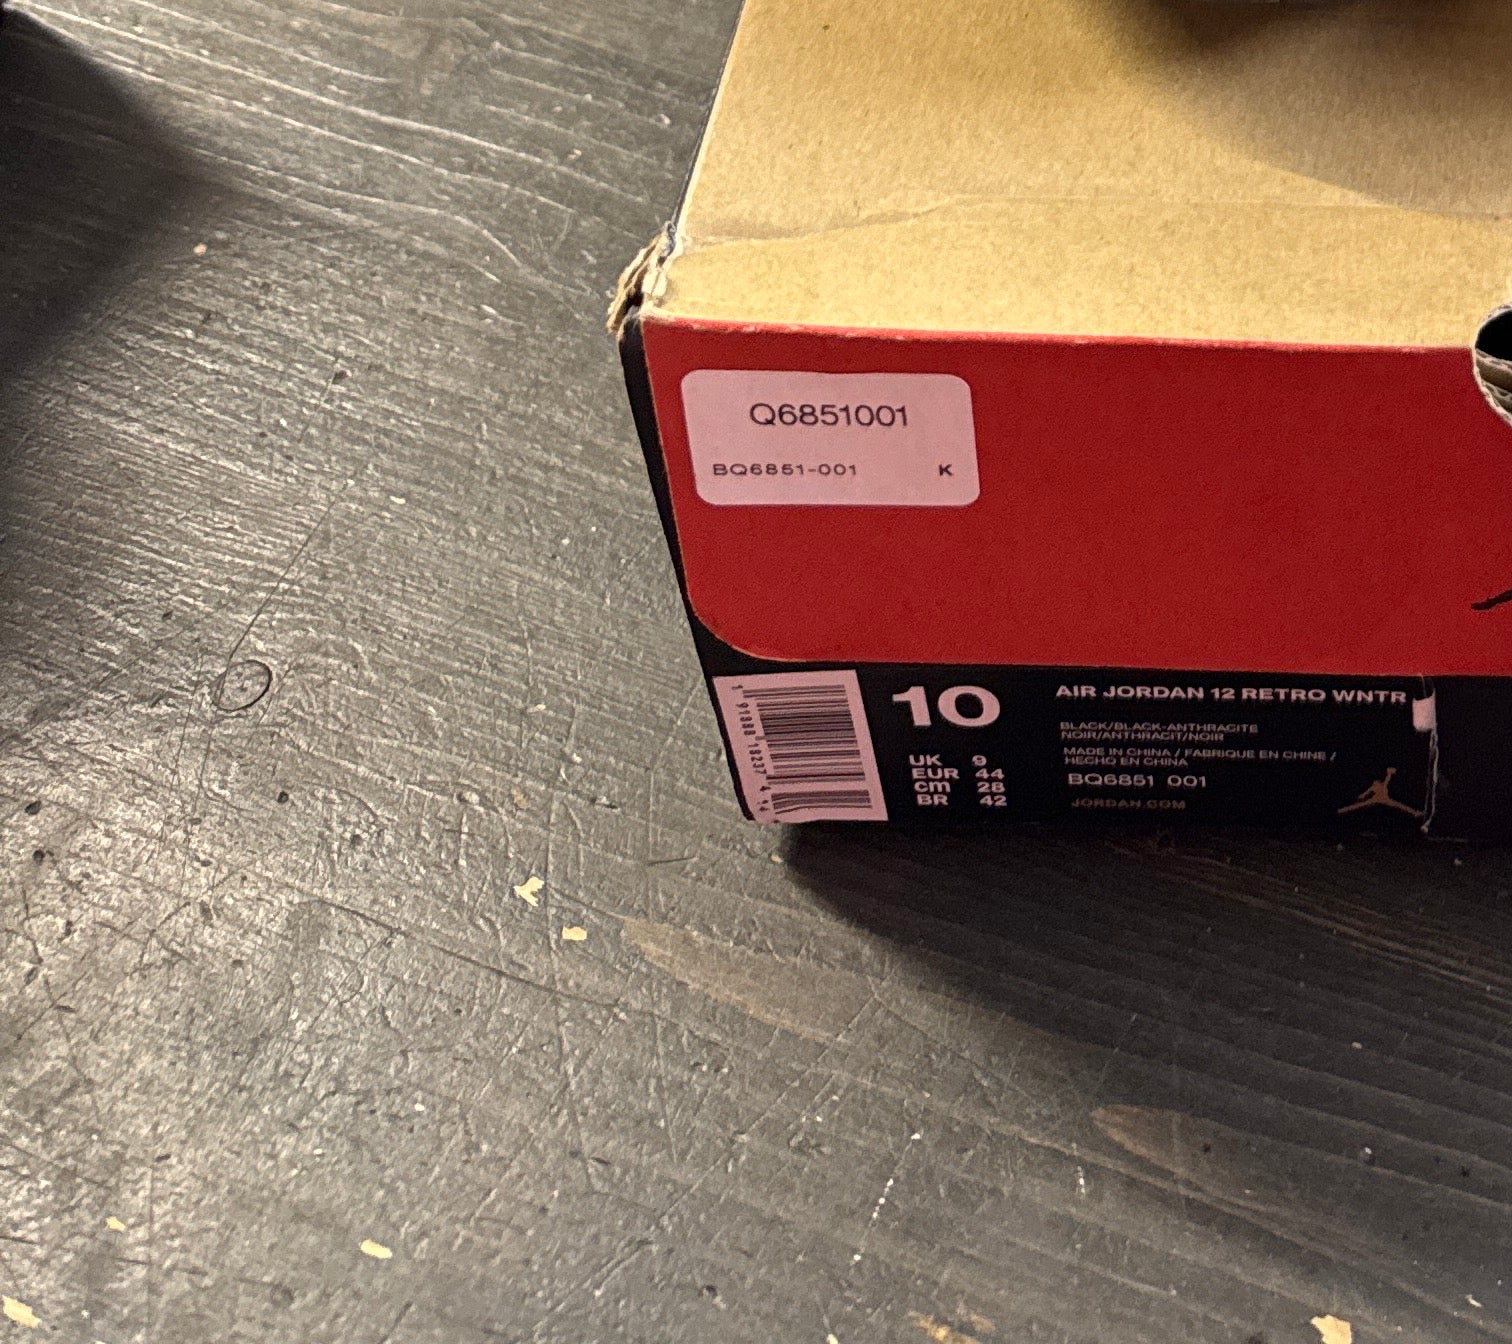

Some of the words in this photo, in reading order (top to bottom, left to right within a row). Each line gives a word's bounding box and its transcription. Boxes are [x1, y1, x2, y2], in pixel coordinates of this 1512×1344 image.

[750, 402, 908, 427] Q6851001
[712, 463, 857, 476] BQ6851-001
[938, 463, 954, 477] K
[1055, 684, 1097, 698] AIR
[1102, 685, 1205, 700] JORDAN
[1210, 687, 1236, 700] 12
[1241, 687, 1326, 702] RETRO
[1331, 689, 1407, 703] WNTR
[892, 684, 1001, 728] 10
[1060, 721, 1259, 733] BLACK/BLACK-ANTHRACITE
[909, 754, 943, 766] UK
[972, 754, 988, 767] 9
[1063, 746, 1105, 756] MADE
[1108, 747, 1123, 756] IN
[1126, 747, 1171, 758] CHINA
[1258, 749, 1279, 760] EN
[1282, 750, 1327, 761] CHINE
[1064, 756, 1117, 766] HECHO
[1119, 757, 1140, 767] EN
[1143, 757, 1189, 767] CHINA
[911, 767, 960, 780] EUR
[975, 767, 1005, 780] 44
[914, 780, 951, 792] cm
[977, 781, 1006, 793] 28
[1166, 774, 1207, 788] 001
[917, 793, 949, 806] BR
[979, 794, 1008, 807] 42
